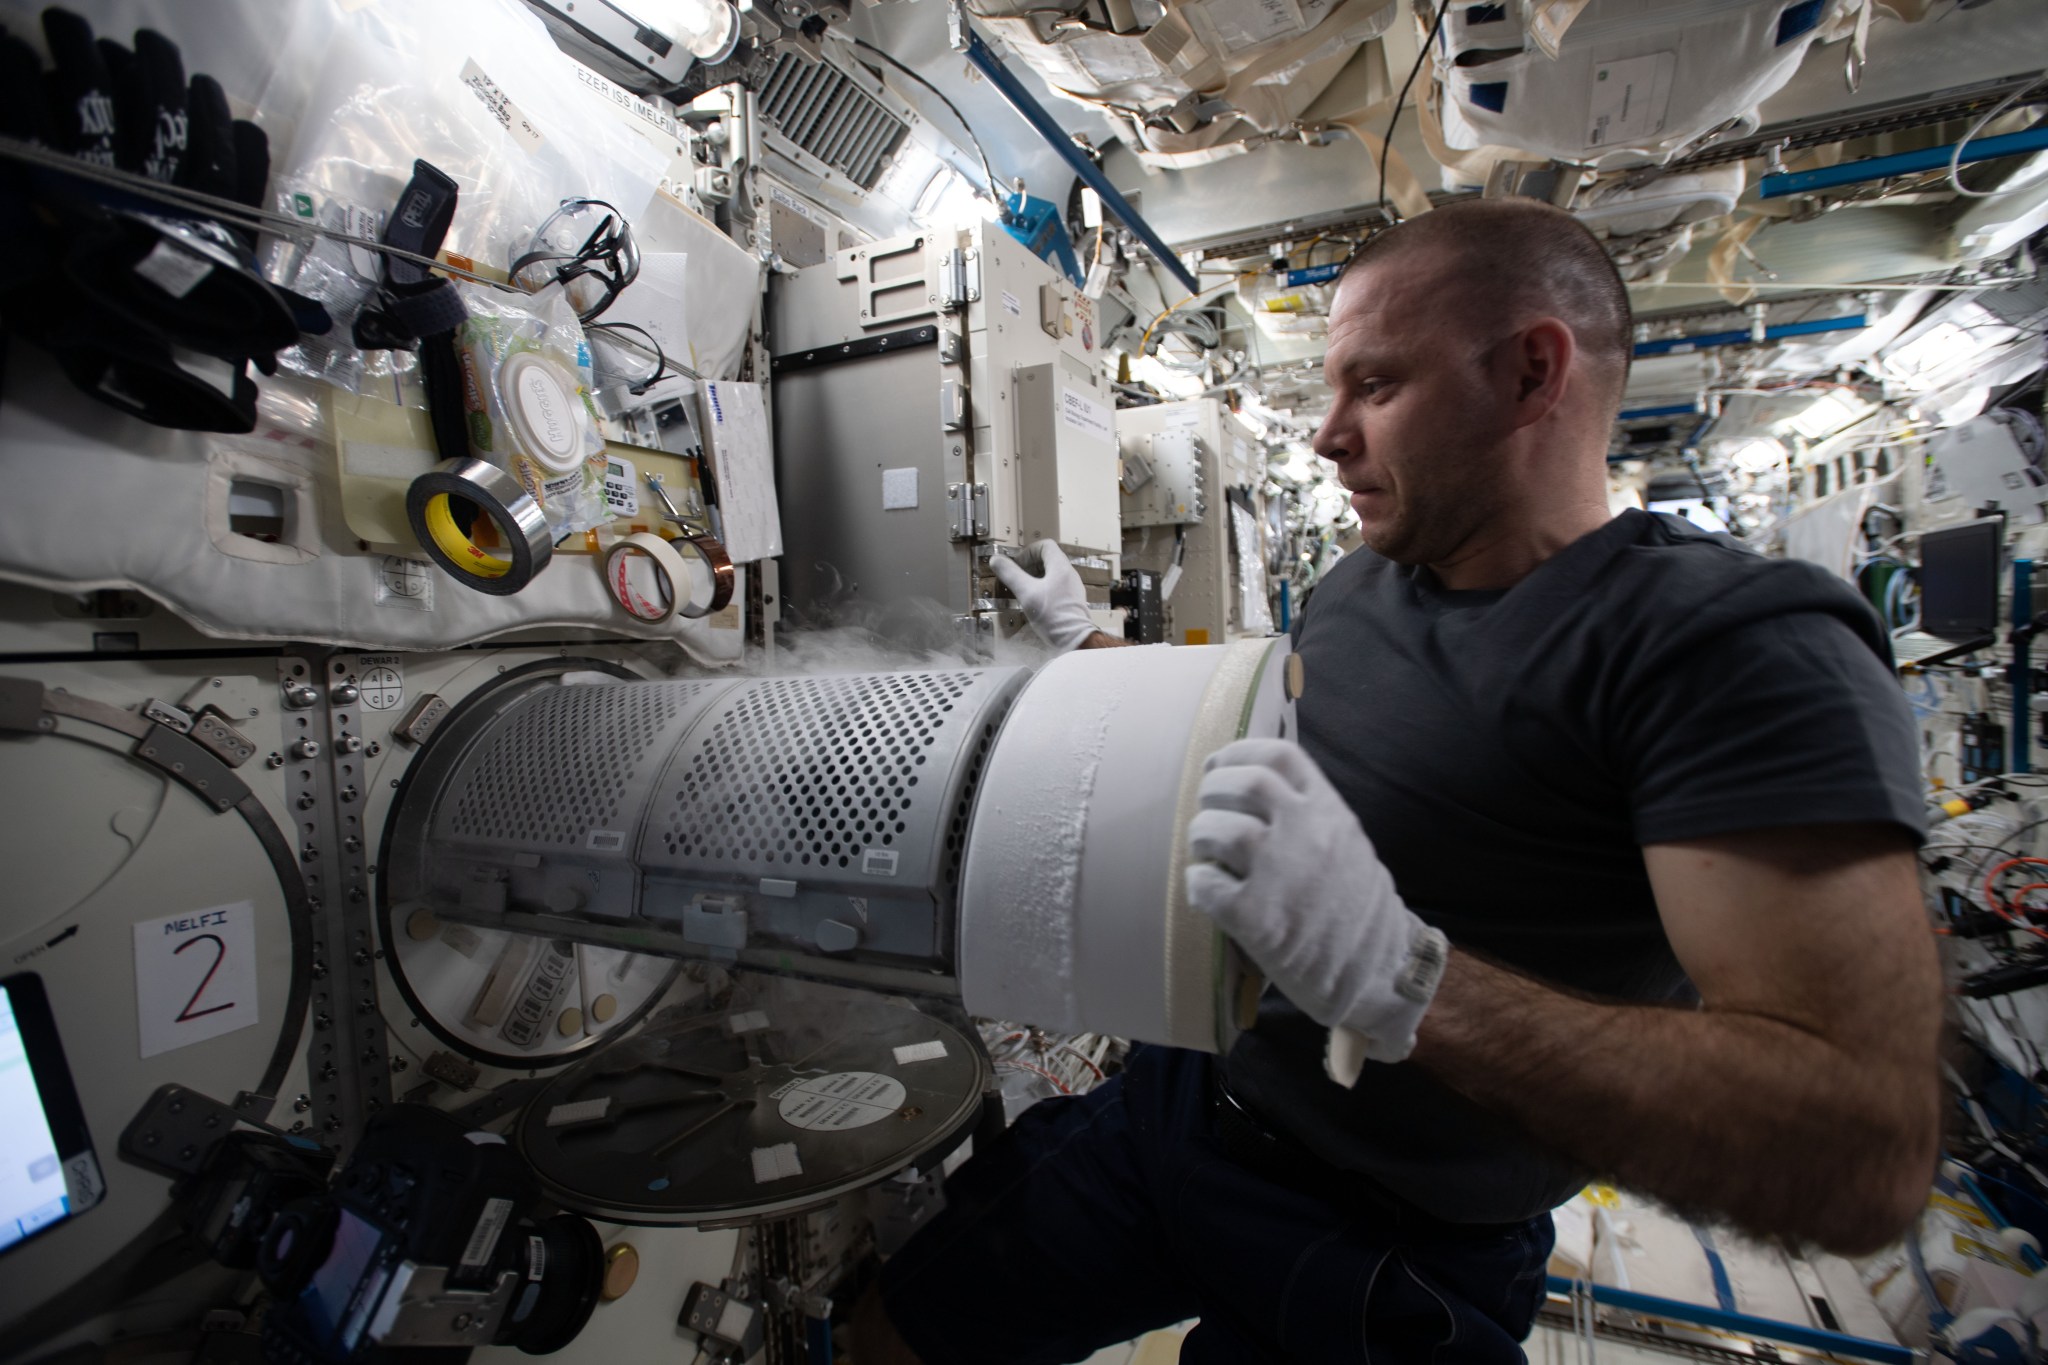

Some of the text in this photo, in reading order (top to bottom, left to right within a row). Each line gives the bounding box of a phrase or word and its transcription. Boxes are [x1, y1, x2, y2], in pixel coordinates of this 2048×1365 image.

[573, 65, 609, 96] EZER
[613, 87, 631, 109] ISS
[634, 100, 674, 133] (MELFI)
[497, 104, 511, 122] Bag
[467, 546, 485, 559] 3M
[395, 558, 402, 567] A
[394, 580, 418, 591] C D
[360, 656, 400, 665] DEWAR 2
[371, 674, 393, 682] A B
[372, 694, 394, 704] C D
[164, 911, 228, 935] MELFI
[173, 934, 235, 1023] 2
[772, 1082, 796, 1098] DEWAR
